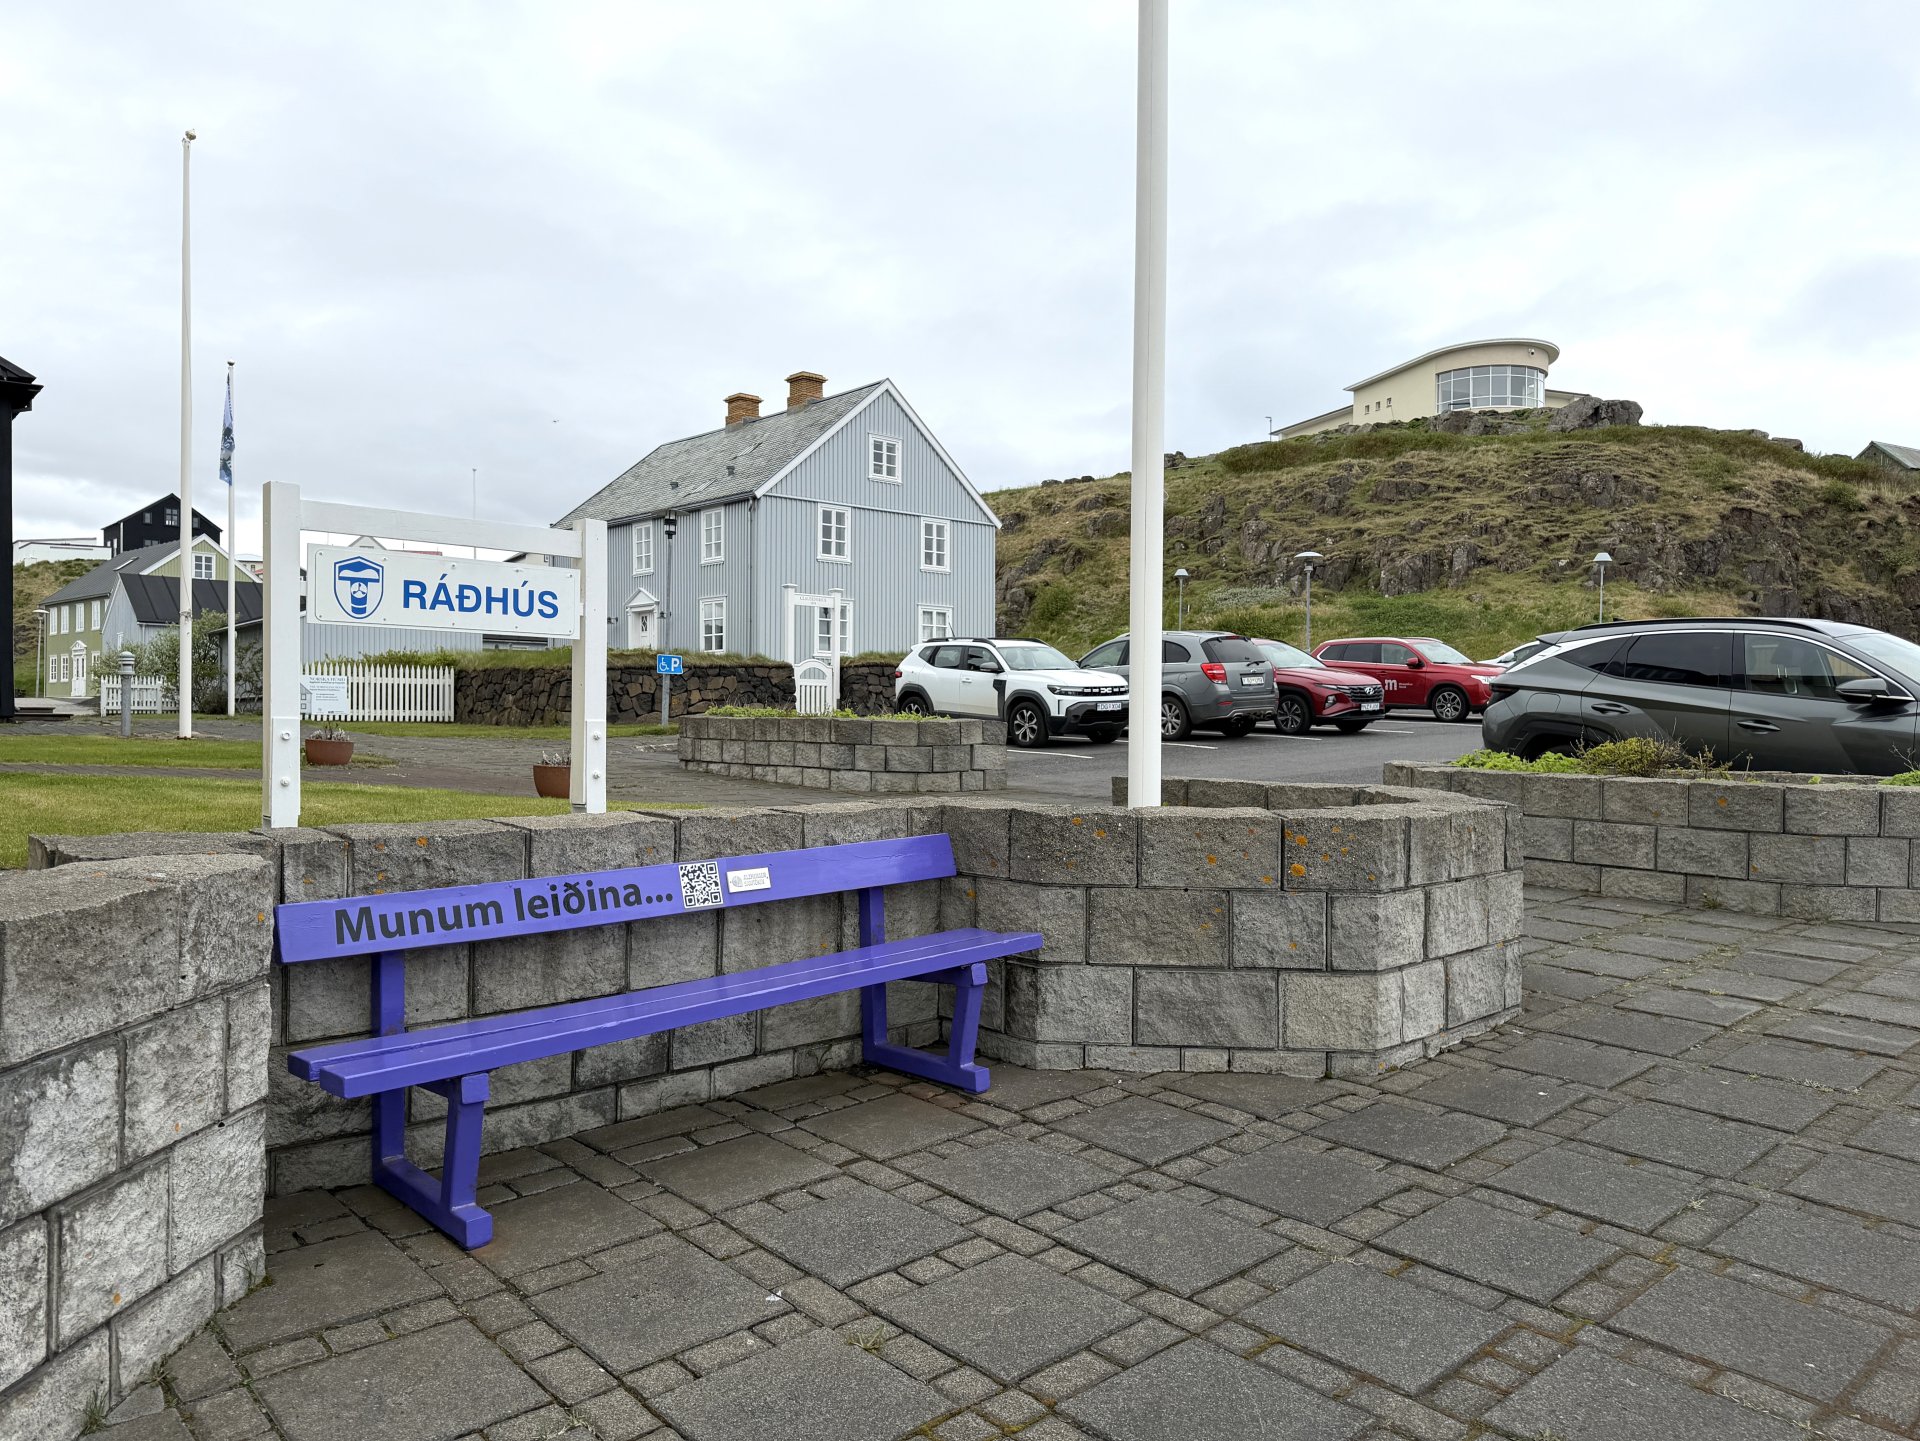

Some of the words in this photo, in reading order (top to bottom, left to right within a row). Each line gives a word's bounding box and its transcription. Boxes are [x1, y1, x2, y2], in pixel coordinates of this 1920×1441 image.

[402, 573, 560, 619] RÁÐHÚS
[671, 657, 680, 672] P
[334, 900, 504, 945] Munum
[513, 879, 673, 922] leiðina...
